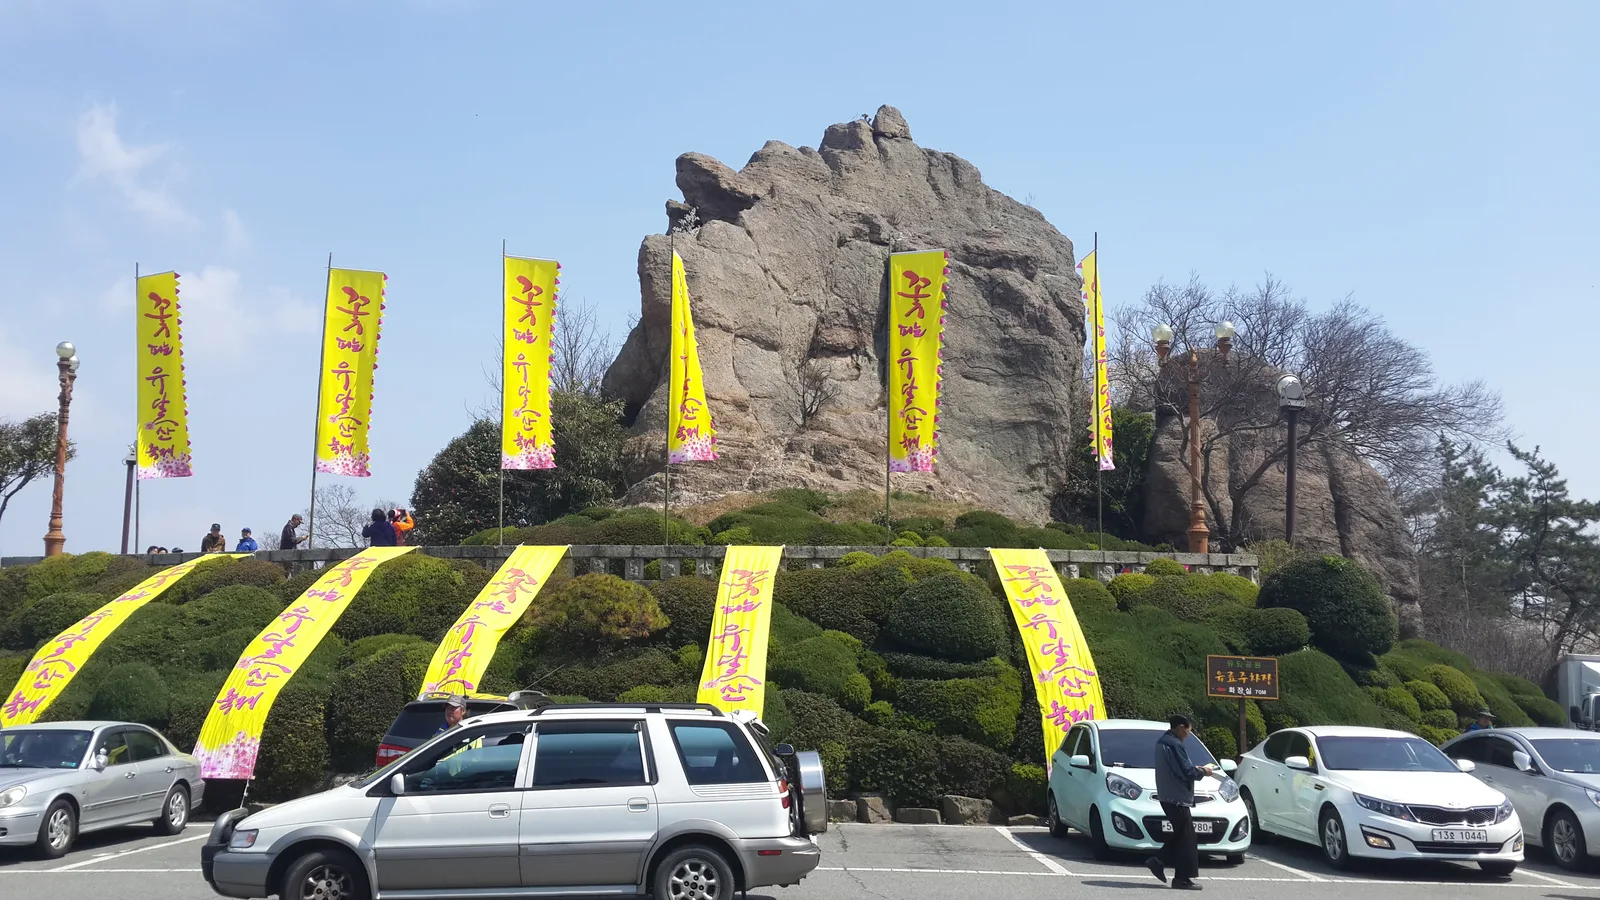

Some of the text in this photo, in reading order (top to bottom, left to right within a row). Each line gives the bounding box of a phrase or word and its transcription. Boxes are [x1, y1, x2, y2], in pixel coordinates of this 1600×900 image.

[1215, 671, 1271, 685] 유료주차장
[1228, 686, 1252, 695] 화장실
[1460, 831, 1481, 840] 1044
